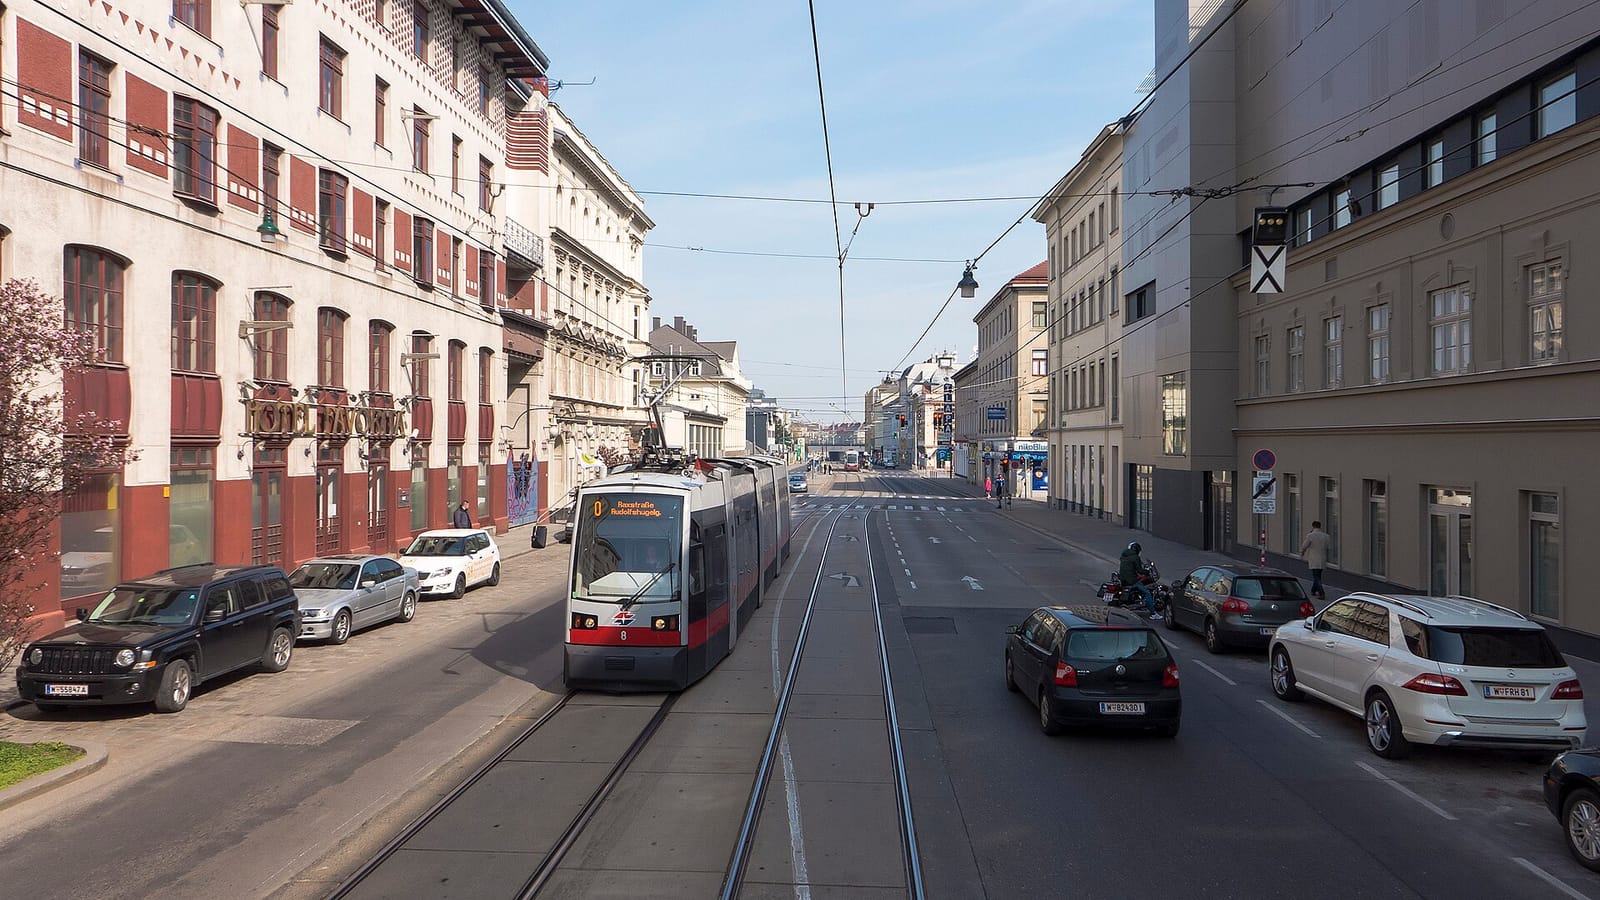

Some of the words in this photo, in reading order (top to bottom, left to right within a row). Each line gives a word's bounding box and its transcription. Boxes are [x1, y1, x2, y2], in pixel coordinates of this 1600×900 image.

[245, 400, 316, 434] HOTEL
[318, 404, 406, 436] FAVORITA
[620, 630, 627, 640] 8
